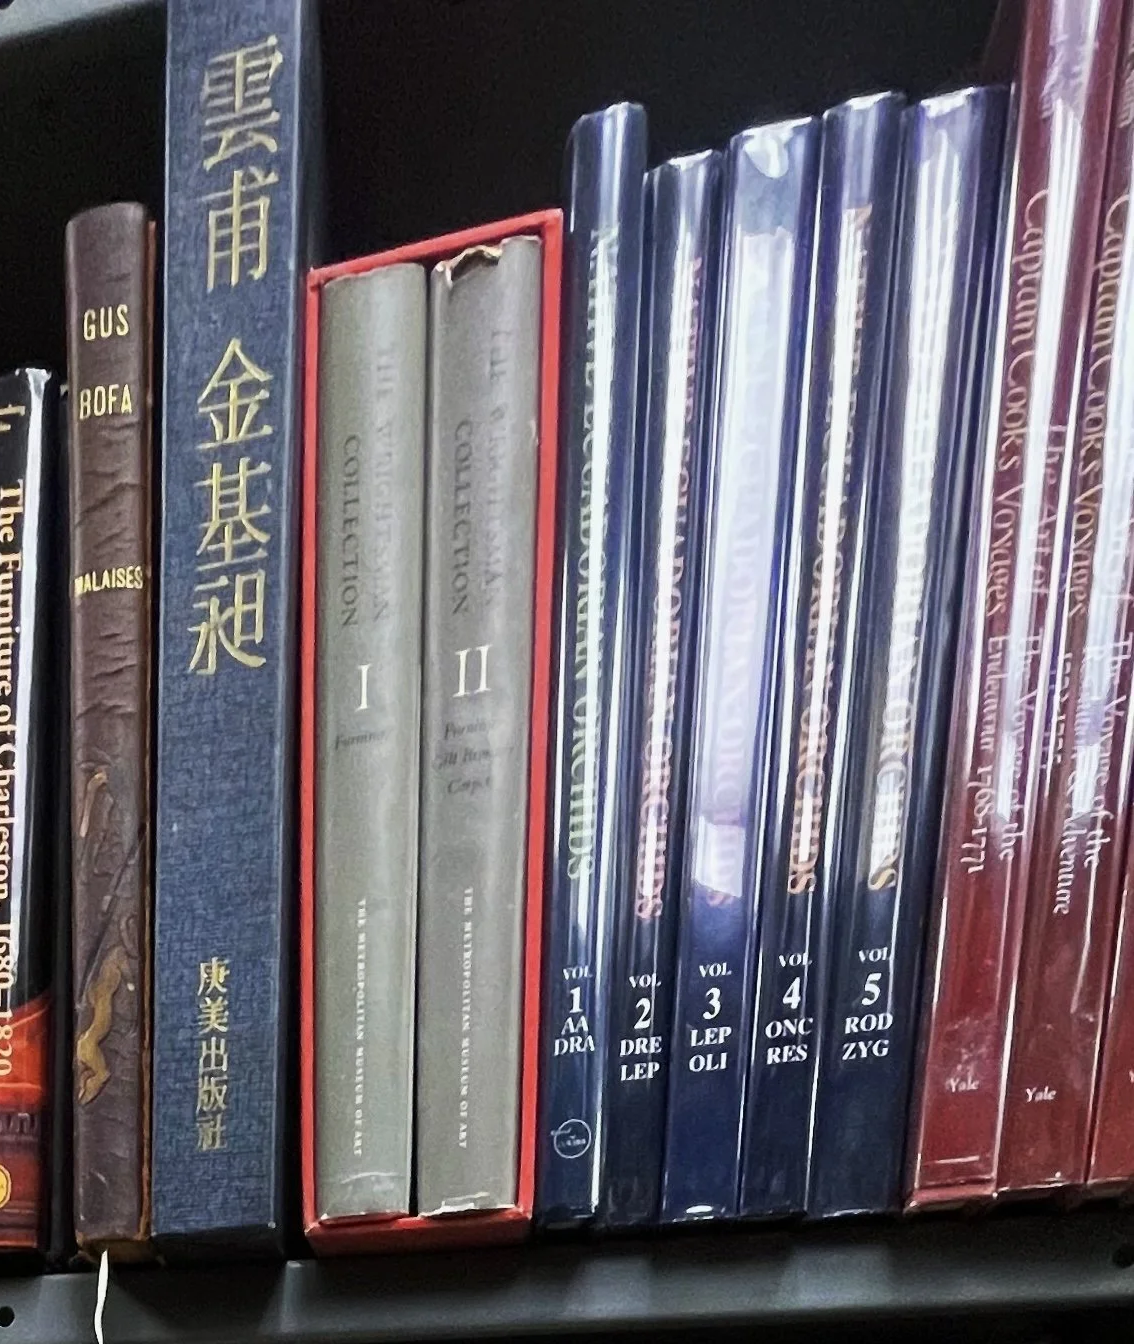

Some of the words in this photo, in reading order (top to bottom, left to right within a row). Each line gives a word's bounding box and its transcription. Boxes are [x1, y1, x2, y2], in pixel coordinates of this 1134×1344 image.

[1012, 189, 1049, 347] Captain
[1094, 194, 1132, 353] Captain
[83, 304, 129, 340] GUS
[79, 384, 133, 418] BOFA
[451, 420, 473, 616] COLLECTION
[342, 434, 361, 627] COLLECTION
[453, 645, 492, 697] II
[355, 664, 370, 713] I
[1084, 829, 1111, 869] the
[778, 951, 813, 969] VOL
[858, 946, 892, 964] VOL
[629, 973, 662, 990] VOL
[698, 962, 732, 979] VOL
[782, 975, 802, 1010] 4
[861, 971, 882, 1006] 5
[569, 987, 583, 1014] 1
[703, 986, 722, 1020] 3
[561, 1013, 589, 1033] AA
[636, 997, 653, 1031] 2
[845, 1012, 894, 1034] ROD
[690, 1026, 733, 1048] LEP
[765, 1016, 813, 1038] ONC
[553, 1034, 596, 1057] DRA
[619, 1035, 663, 1058] DRE
[766, 1042, 808, 1065] RES
[842, 1039, 890, 1062] ZYG
[620, 1061, 661, 1084] LEP
[689, 1051, 729, 1074] OLI
[947, 1076, 981, 1093] Yale
[1025, 1085, 1057, 1103] Yale
